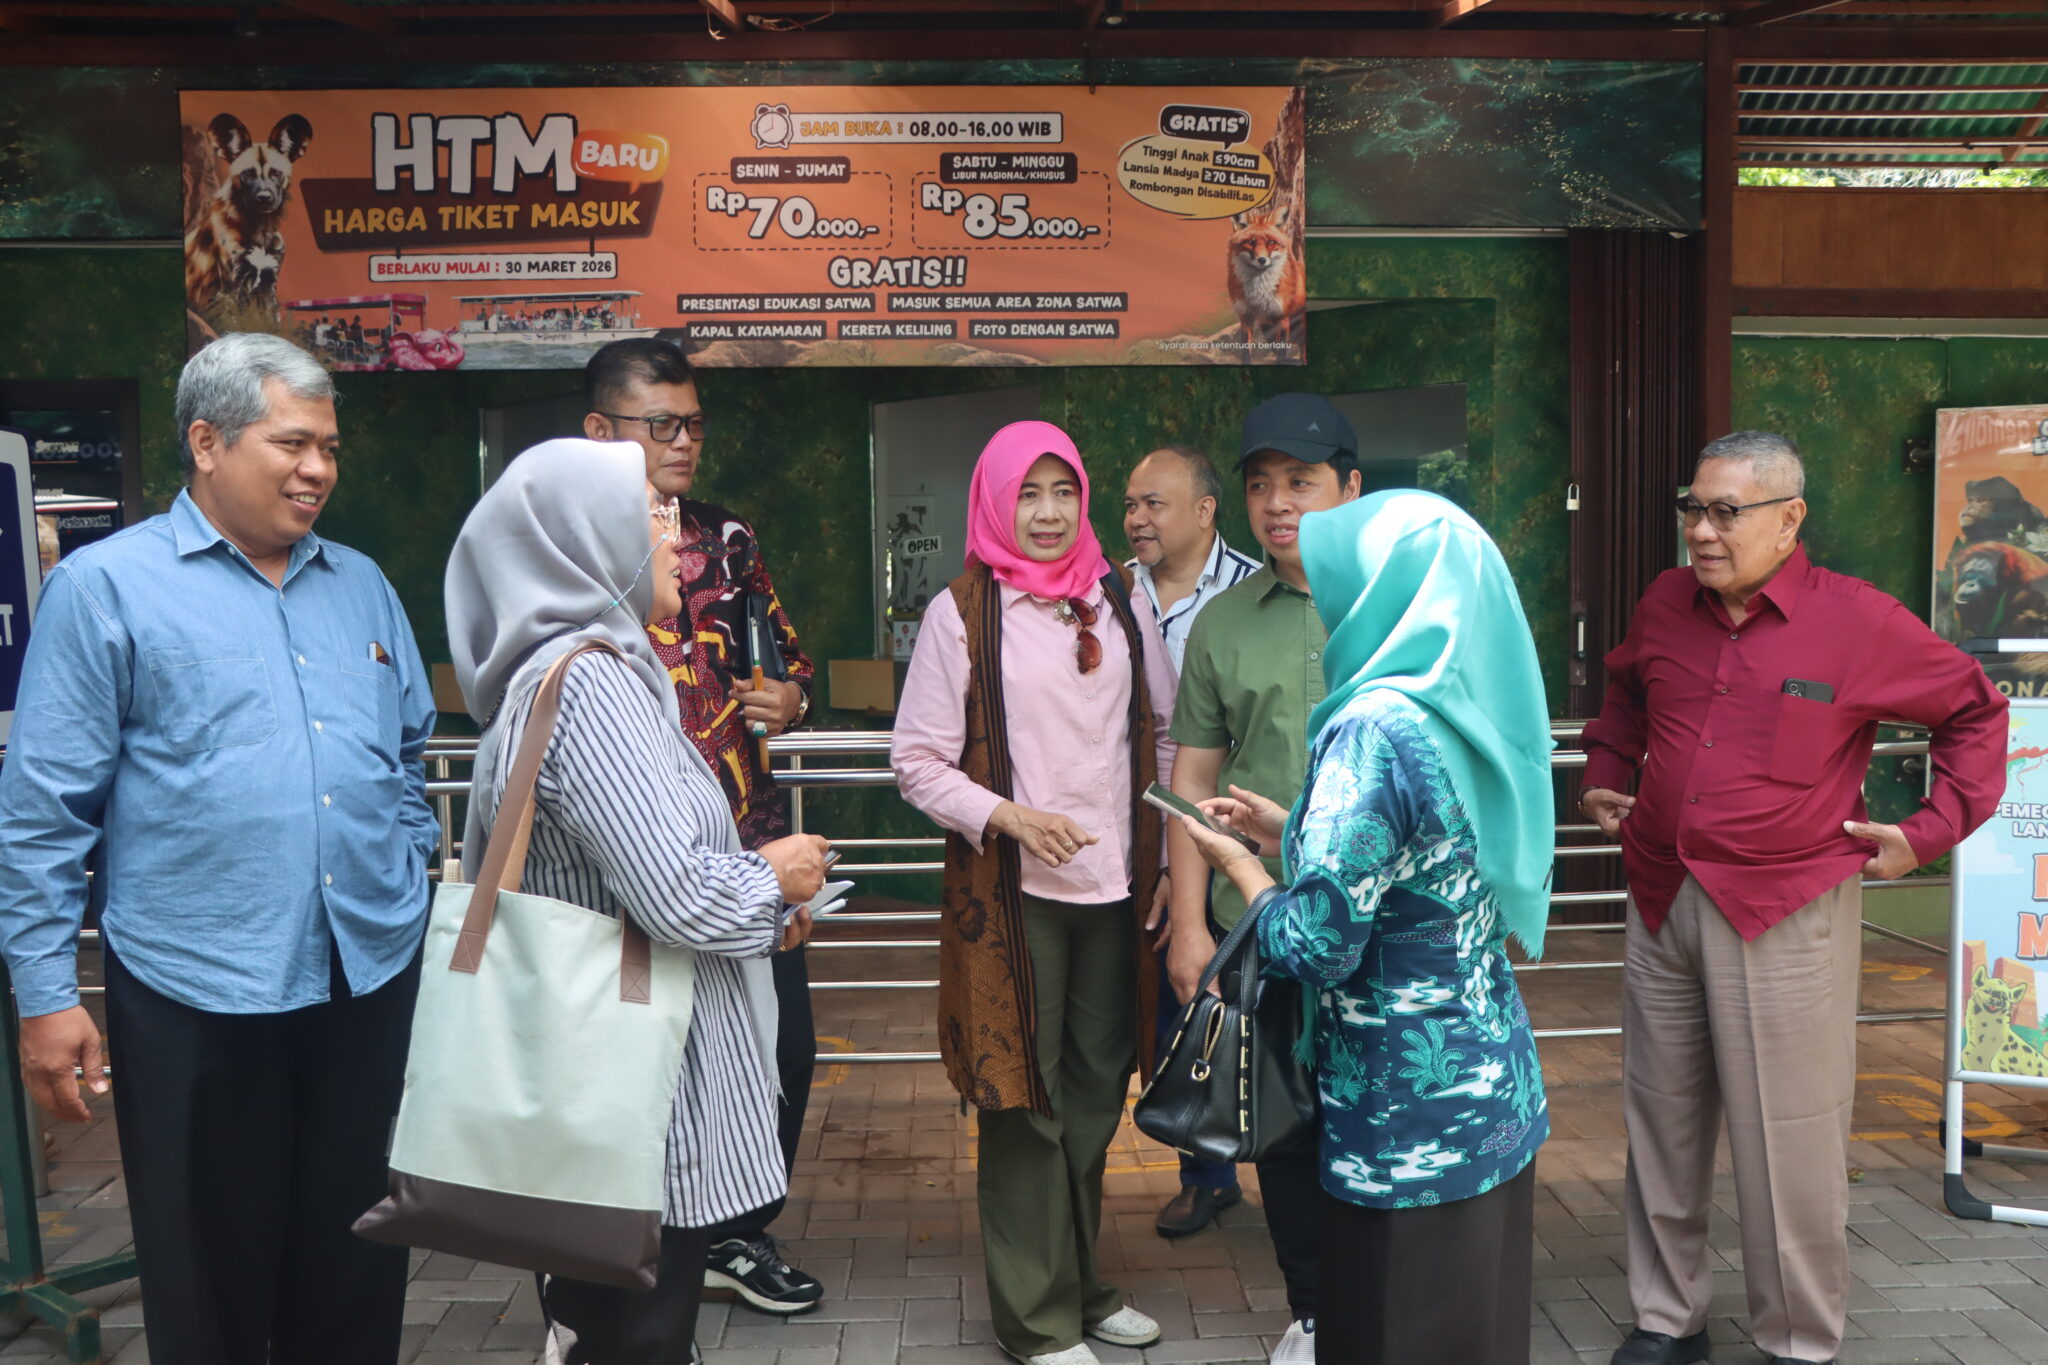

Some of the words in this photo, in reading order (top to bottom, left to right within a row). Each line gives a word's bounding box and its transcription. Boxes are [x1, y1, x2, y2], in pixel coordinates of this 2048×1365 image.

[800, 120, 840, 137] JAM
[844, 120, 893, 137] BUKA
[909, 119, 1015, 138] 08.00-16.00
[1018, 119, 1052, 137] WIB
[372, 112, 578, 195] HTM
[580, 140, 660, 171] BARU
[952, 154, 996, 169] SABTU
[1012, 154, 1065, 169] MINGGU
[1142, 145, 1177, 162] Tinggi
[1181, 149, 1210, 163] Anak
[736, 163, 779, 178] SENIN
[796, 162, 846, 178] JUMAT
[952, 171, 978, 181] LIBUR
[979, 170, 1066, 181] NASIONAL/KHUSUS
[1123, 162, 1160, 175] Lansia
[1163, 165, 1200, 180] Madya
[1229, 172, 1266, 188] tahun
[1129, 179, 1194, 198] Rombongan
[1197, 186, 1256, 203] Disabilitas
[324, 206, 428, 234] HARGA
[438, 203, 520, 231] TIKET
[531, 200, 641, 228] MASUK
[376, 261, 441, 276] BERLAKU
[446, 261, 491, 275] MULAI
[505, 260, 522, 274] 30
[527, 260, 577, 274] MARET
[581, 260, 612, 273] 2026
[828, 256, 968, 288] GRATIS!!
[682, 298, 760, 311] PRESENTASI
[764, 297, 821, 310] EDUKASI
[825, 297, 872, 310] SATWA
[892, 296, 941, 310] MASUK
[944, 296, 992, 309] SEMUA
[995, 296, 1033, 309] AREA
[1036, 296, 1073, 309] ZONA
[1076, 295, 1122, 309] SATWA
[690, 325, 734, 338] KAPAL
[737, 324, 822, 338] KATAMARAN
[841, 324, 892, 337] KERETA
[896, 323, 952, 337] KELILING
[974, 323, 1006, 337] FOTO
[1011, 323, 1066, 336] DENGAN
[1069, 323, 1115, 336] SATWA
[1210, 340, 1256, 350] ketentuan
[1258, 340, 1292, 350] berlaku
[908, 538, 938, 553] OPEN
